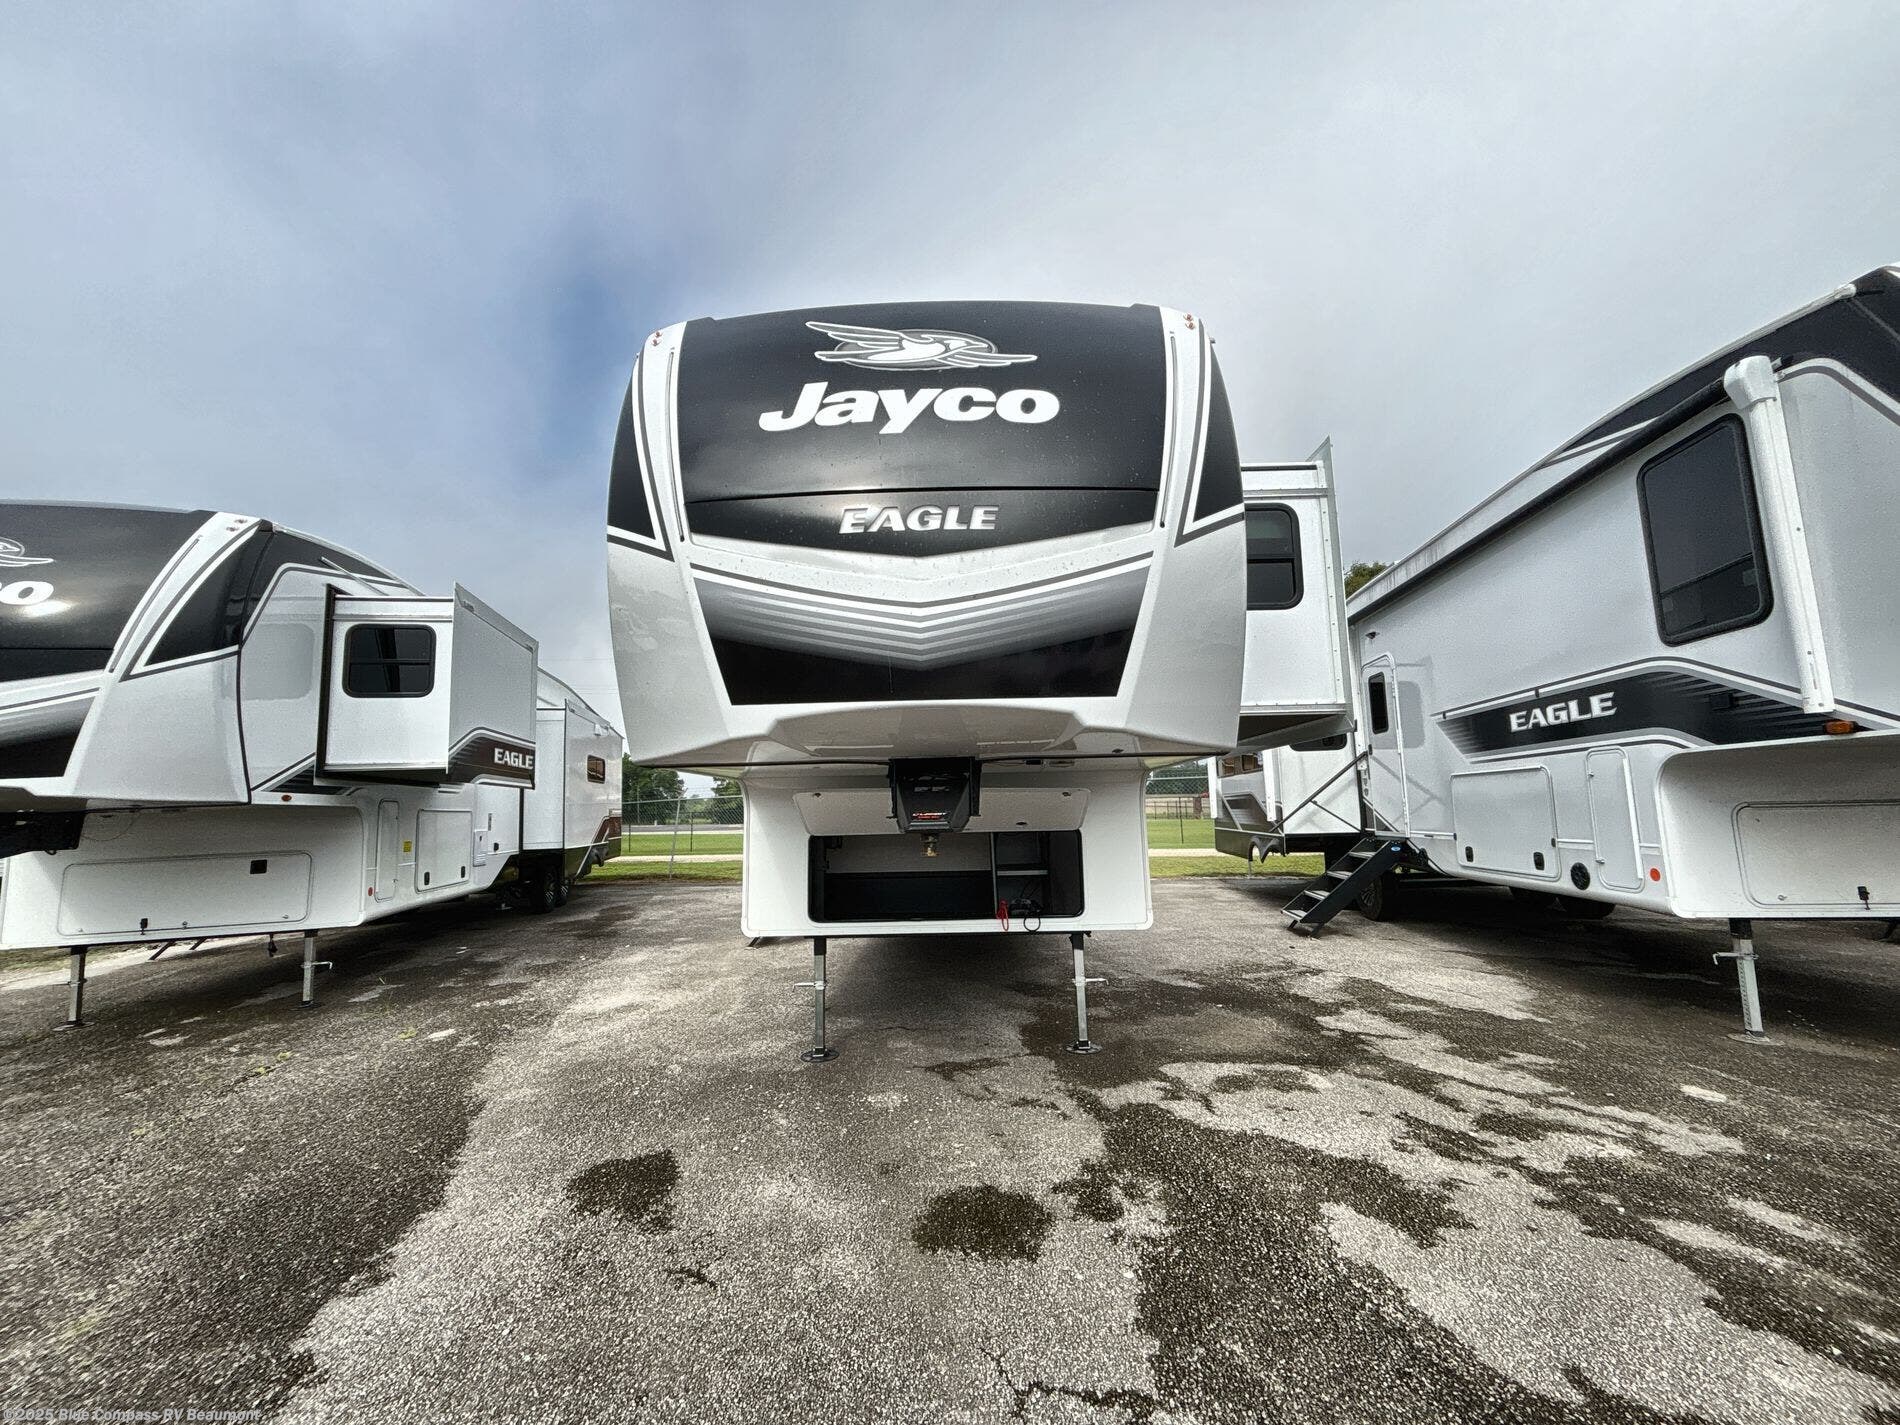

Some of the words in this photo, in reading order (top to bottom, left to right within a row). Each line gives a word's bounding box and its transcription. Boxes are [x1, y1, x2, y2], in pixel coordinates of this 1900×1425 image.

[758, 381, 1060, 435] Jayco
[838, 504, 999, 535] EAGLE
[1509, 691, 1618, 733] EAGLE
[493, 747, 534, 770] EAGLE
